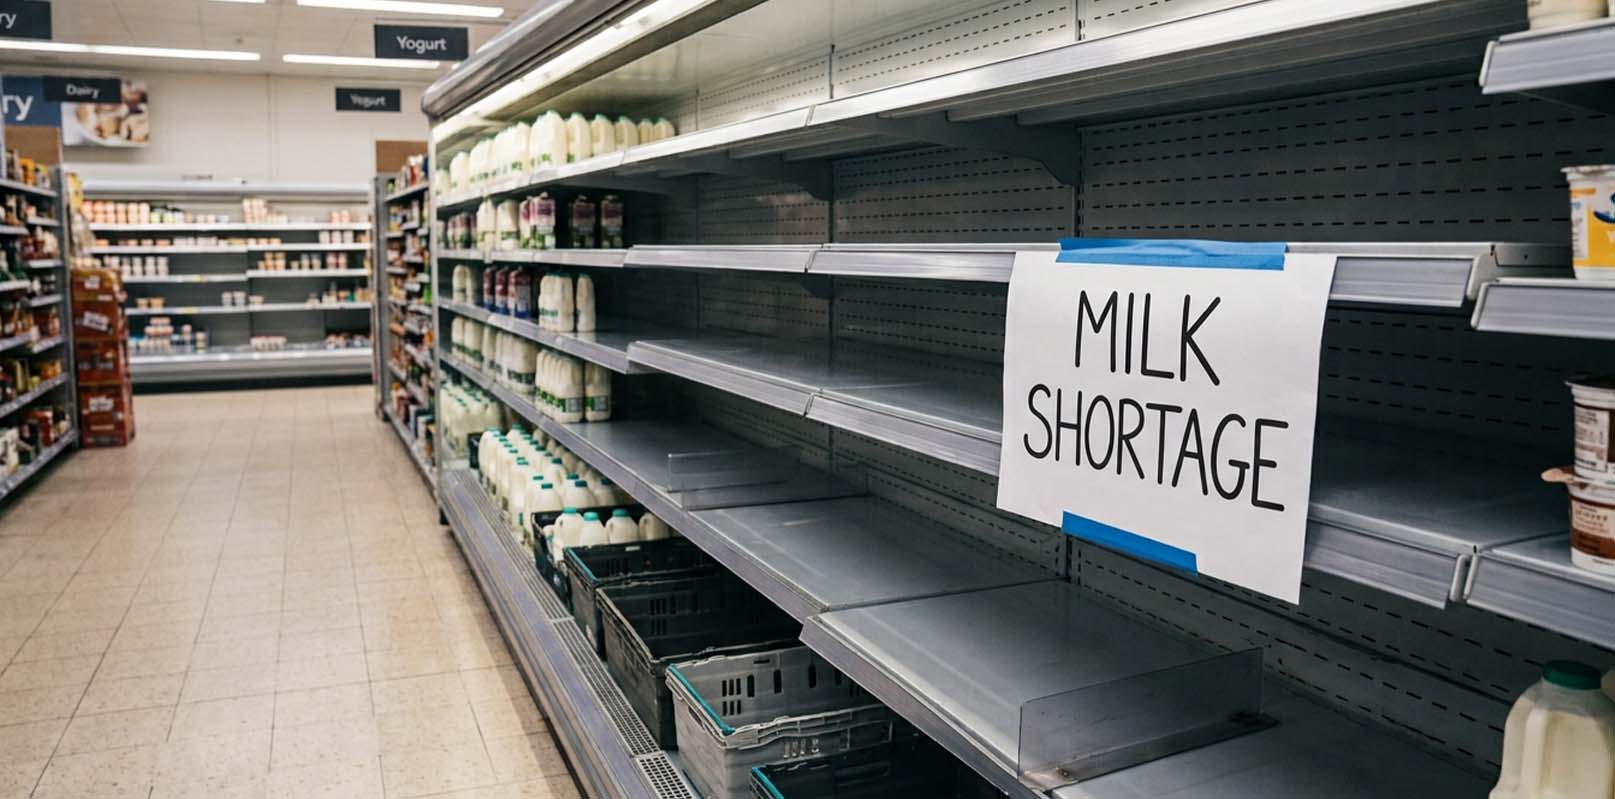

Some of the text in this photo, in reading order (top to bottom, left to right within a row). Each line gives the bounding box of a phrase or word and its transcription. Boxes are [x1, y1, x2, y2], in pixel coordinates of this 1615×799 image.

[397, 35, 447, 54] Yogurt
[66, 83, 100, 99] Dairy
[2, 94, 34, 121] ry
[1075, 290, 1221, 386] MILK
[1023, 383, 1289, 512] SHORTAGE
